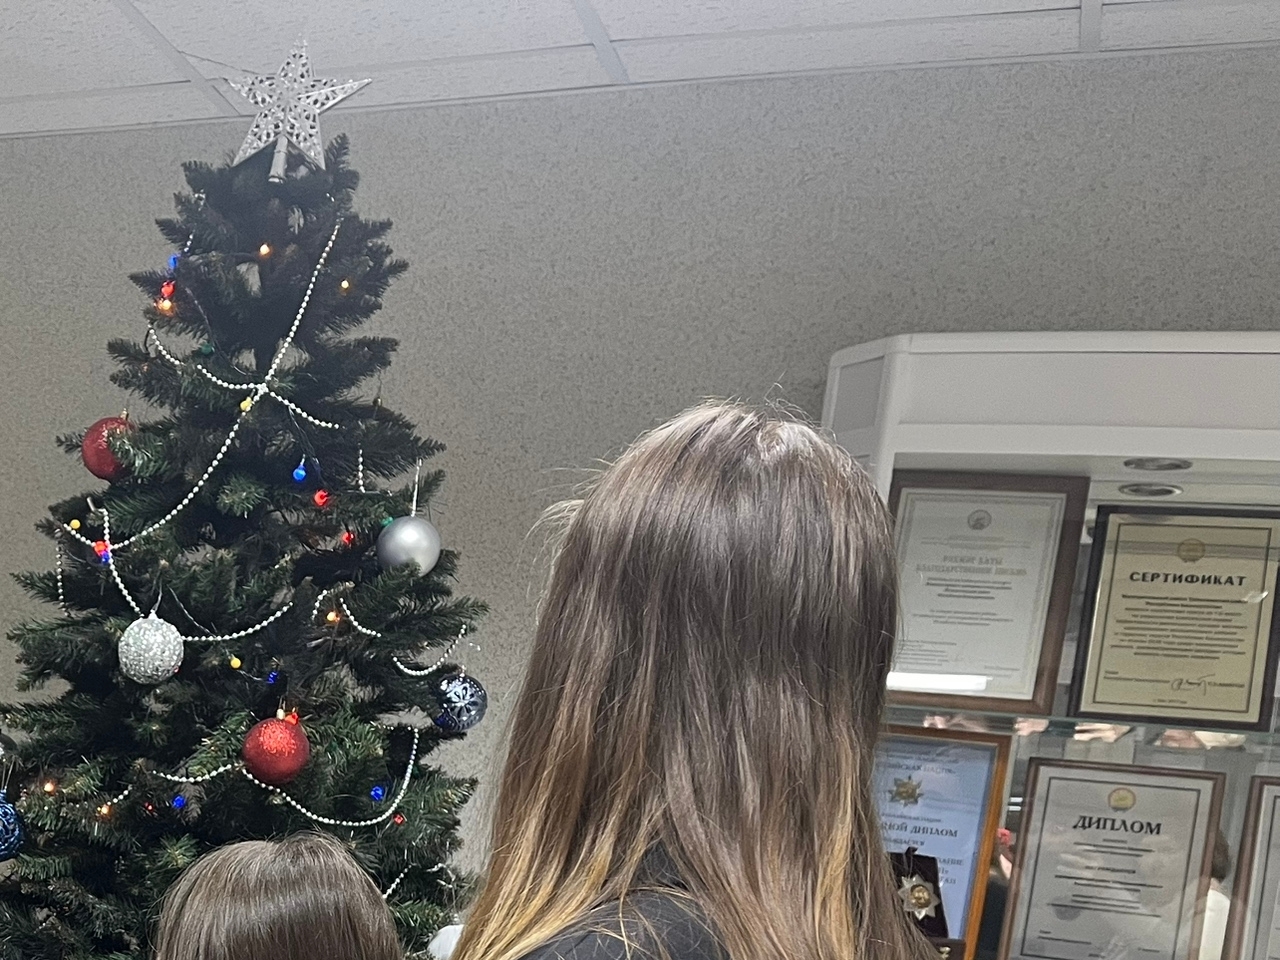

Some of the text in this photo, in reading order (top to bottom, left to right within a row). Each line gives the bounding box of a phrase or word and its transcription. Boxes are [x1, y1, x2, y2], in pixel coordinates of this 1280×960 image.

[1129, 571, 1247, 587] СЕРТИФИКАТ
[910, 825, 958, 837] ДИПЛОМ
[1072, 815, 1162, 835] ДИПЛОМ
